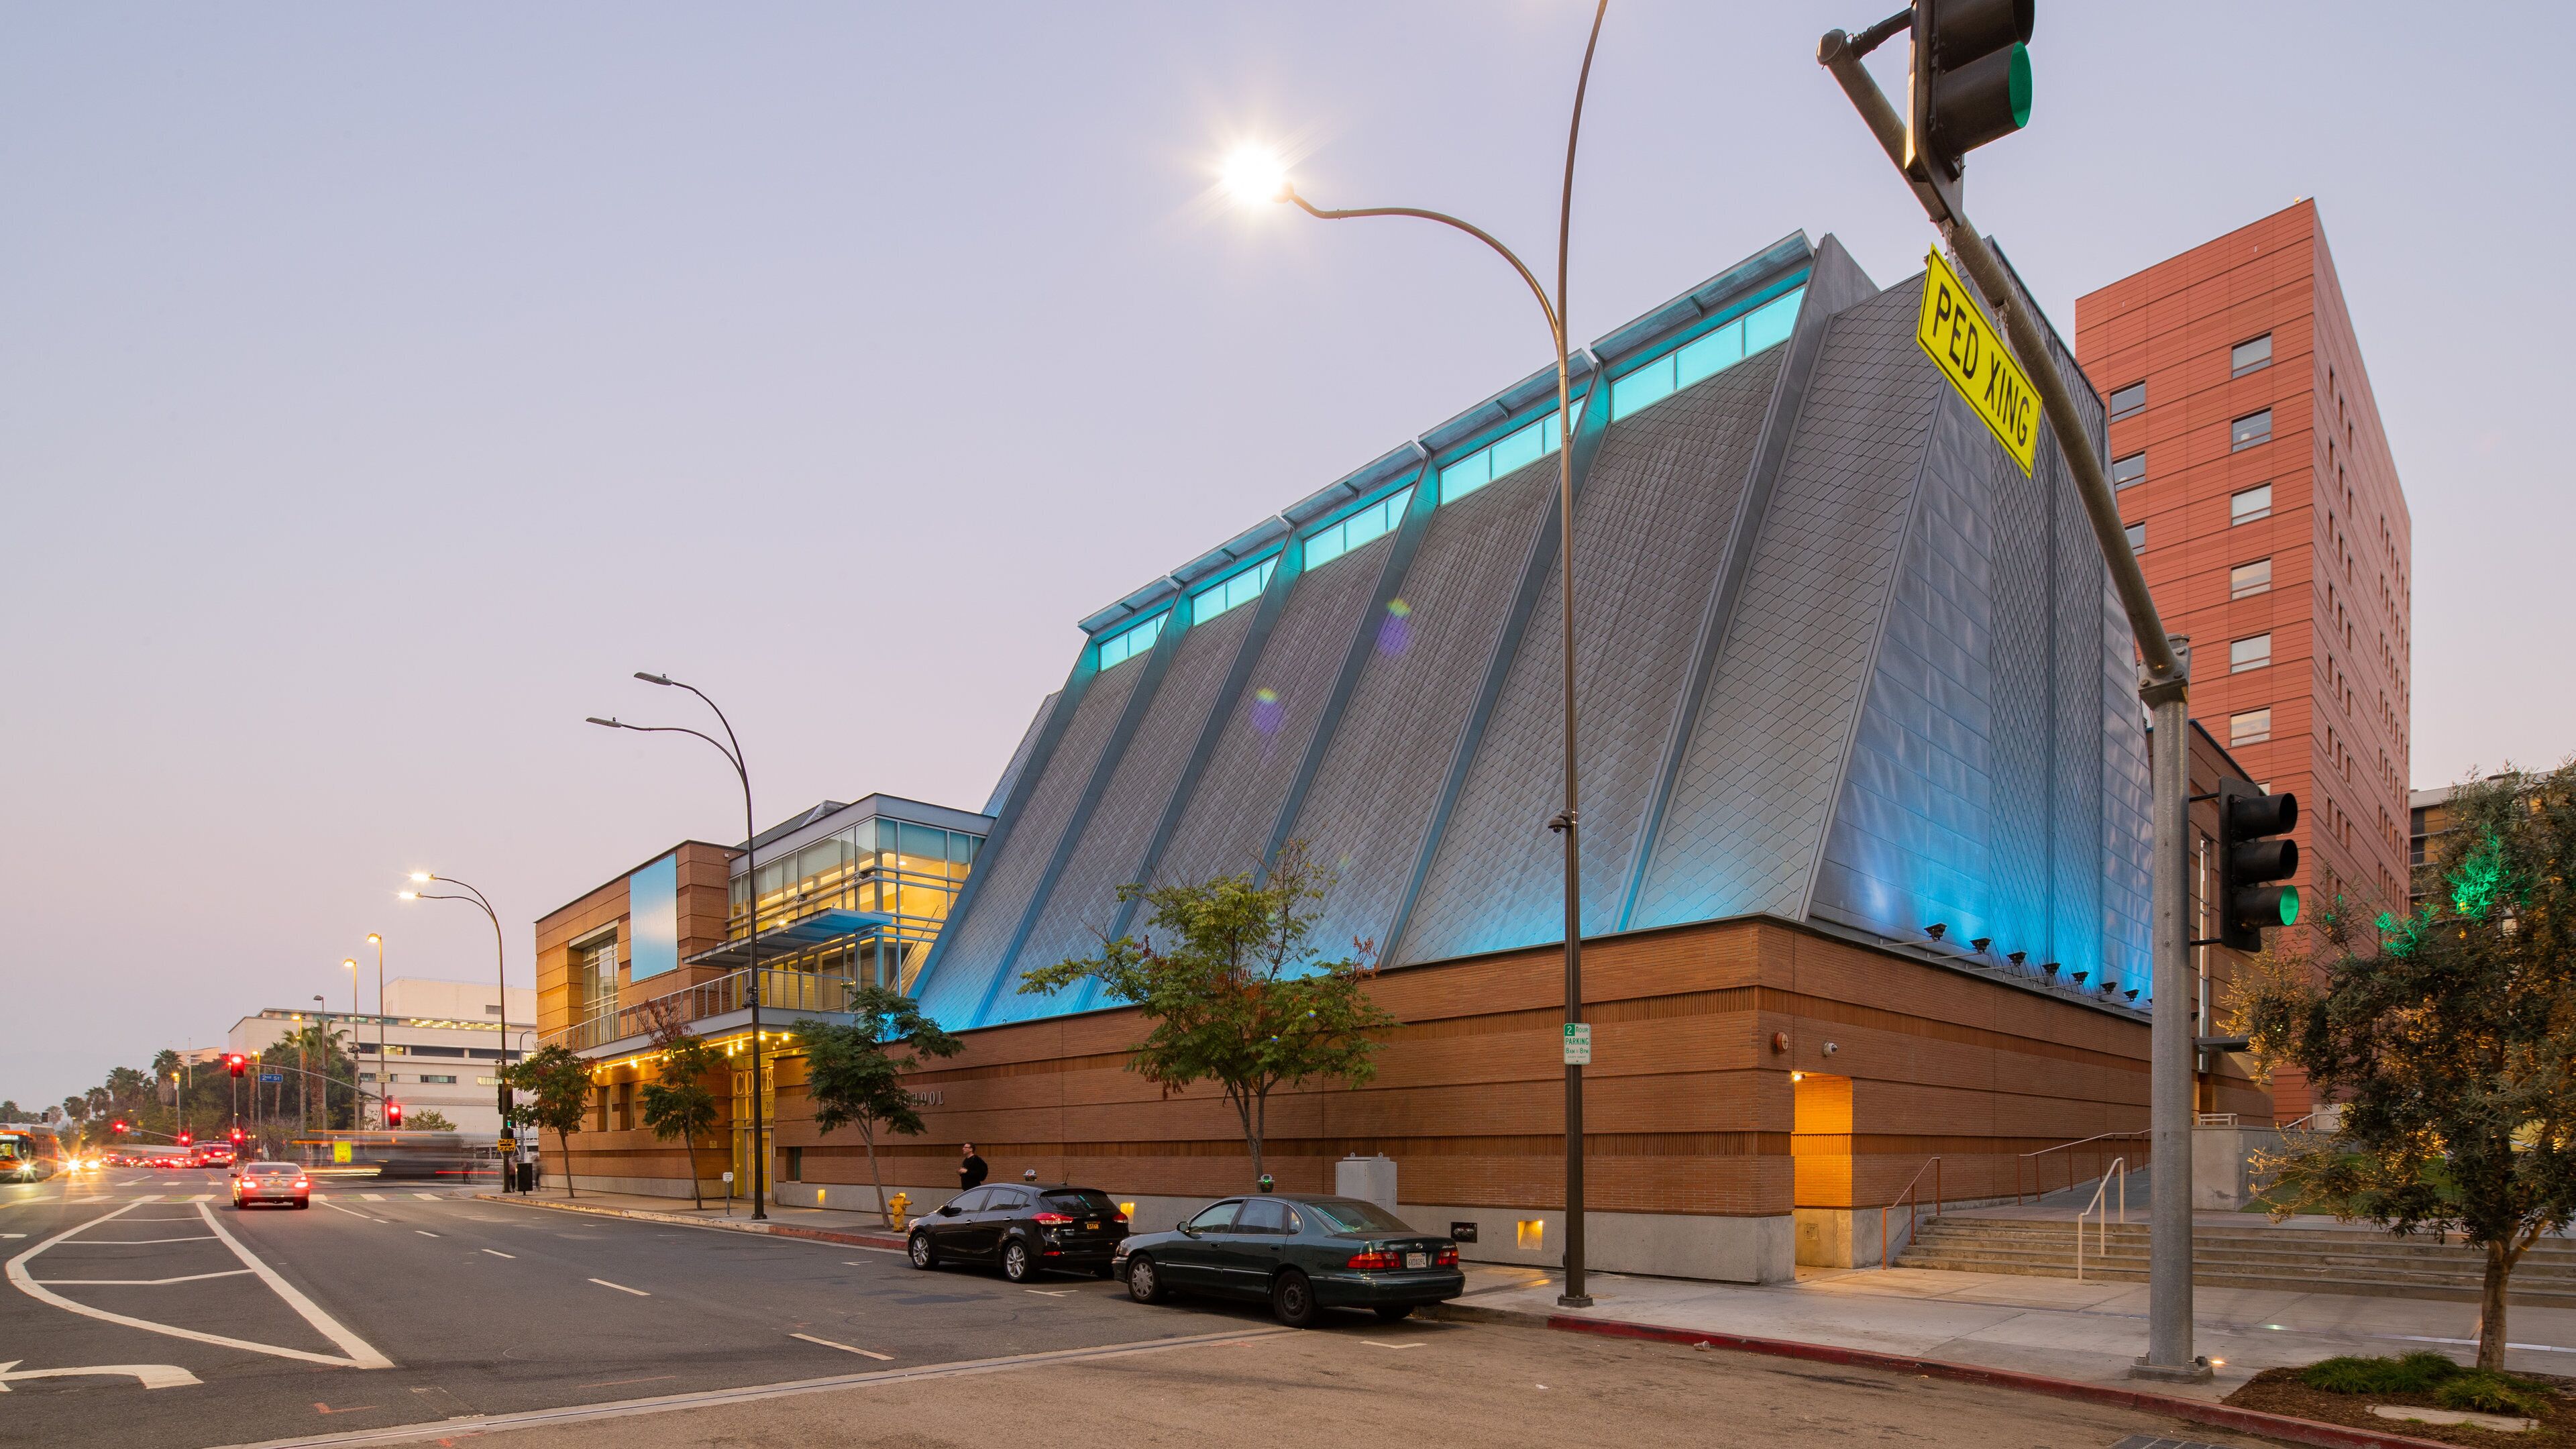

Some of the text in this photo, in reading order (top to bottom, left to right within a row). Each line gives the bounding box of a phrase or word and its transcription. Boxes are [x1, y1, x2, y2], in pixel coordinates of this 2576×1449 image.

[1933, 282, 2030, 447] PED XING
[1567, 1026, 1572, 1035] 2
[735, 1069, 774, 1095] COB
